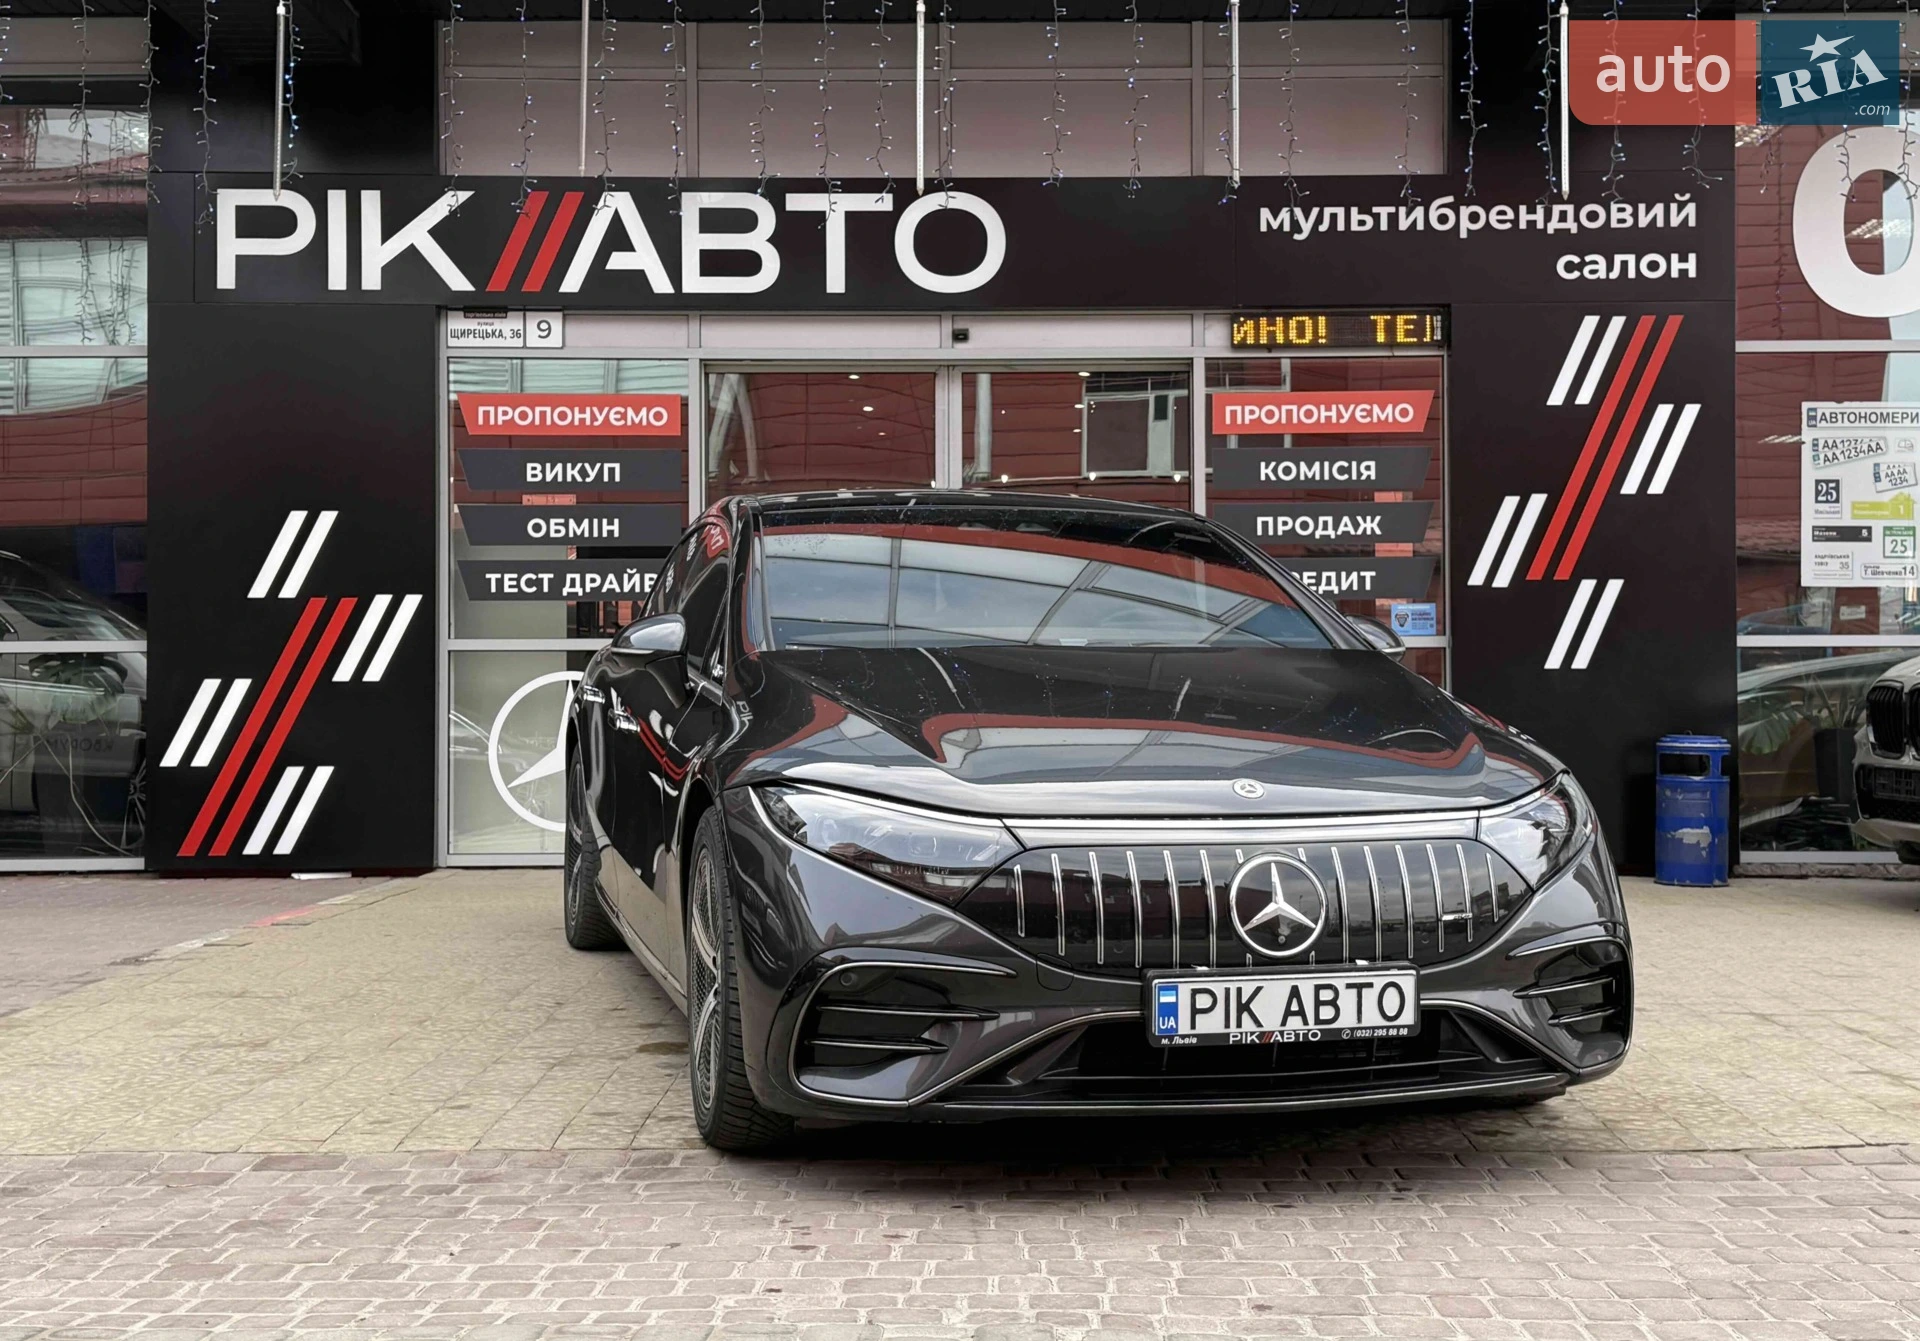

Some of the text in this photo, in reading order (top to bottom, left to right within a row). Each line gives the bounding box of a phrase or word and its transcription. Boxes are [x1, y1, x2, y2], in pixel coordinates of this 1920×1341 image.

[1259, 192, 1697, 240] мультибрендовий
[216, 188, 1006, 294] РІК АВТО
[1555, 249, 1697, 279] салон
[450, 328, 522, 340] ЩИРЕЦЬКА, 36
[536, 319, 552, 339] 9
[477, 406, 668, 426] ПРОПОНУЄМО
[1225, 403, 1414, 425] ПРОПОНУЄМО
[1818, 411, 1919, 424] АВТОНОМЕРИ
[526, 463, 621, 482] ВИКУП
[1259, 461, 1377, 481] КОМІСІЯ
[1817, 482, 1837, 501] 25
[527, 517, 620, 538] ОБМІН
[1256, 516, 1382, 539] ПРОДАЖ
[1890, 539, 1908, 554] 25
[1839, 561, 1849, 570] 35
[1902, 565, 1915, 576] 14
[485, 573, 554, 593] ТЕСТ
[1291, 571, 1377, 594] ЕДИТ
[1190, 980, 1406, 1031] РІК АВТО
[1159, 1016, 1177, 1030] UA
[1353, 1028, 1373, 1037] (032)
[1373, 1028, 1387, 1036] 295
[1172, 1036, 1197, 1045] Львів
[1270, 1030, 1322, 1043] АВТО
